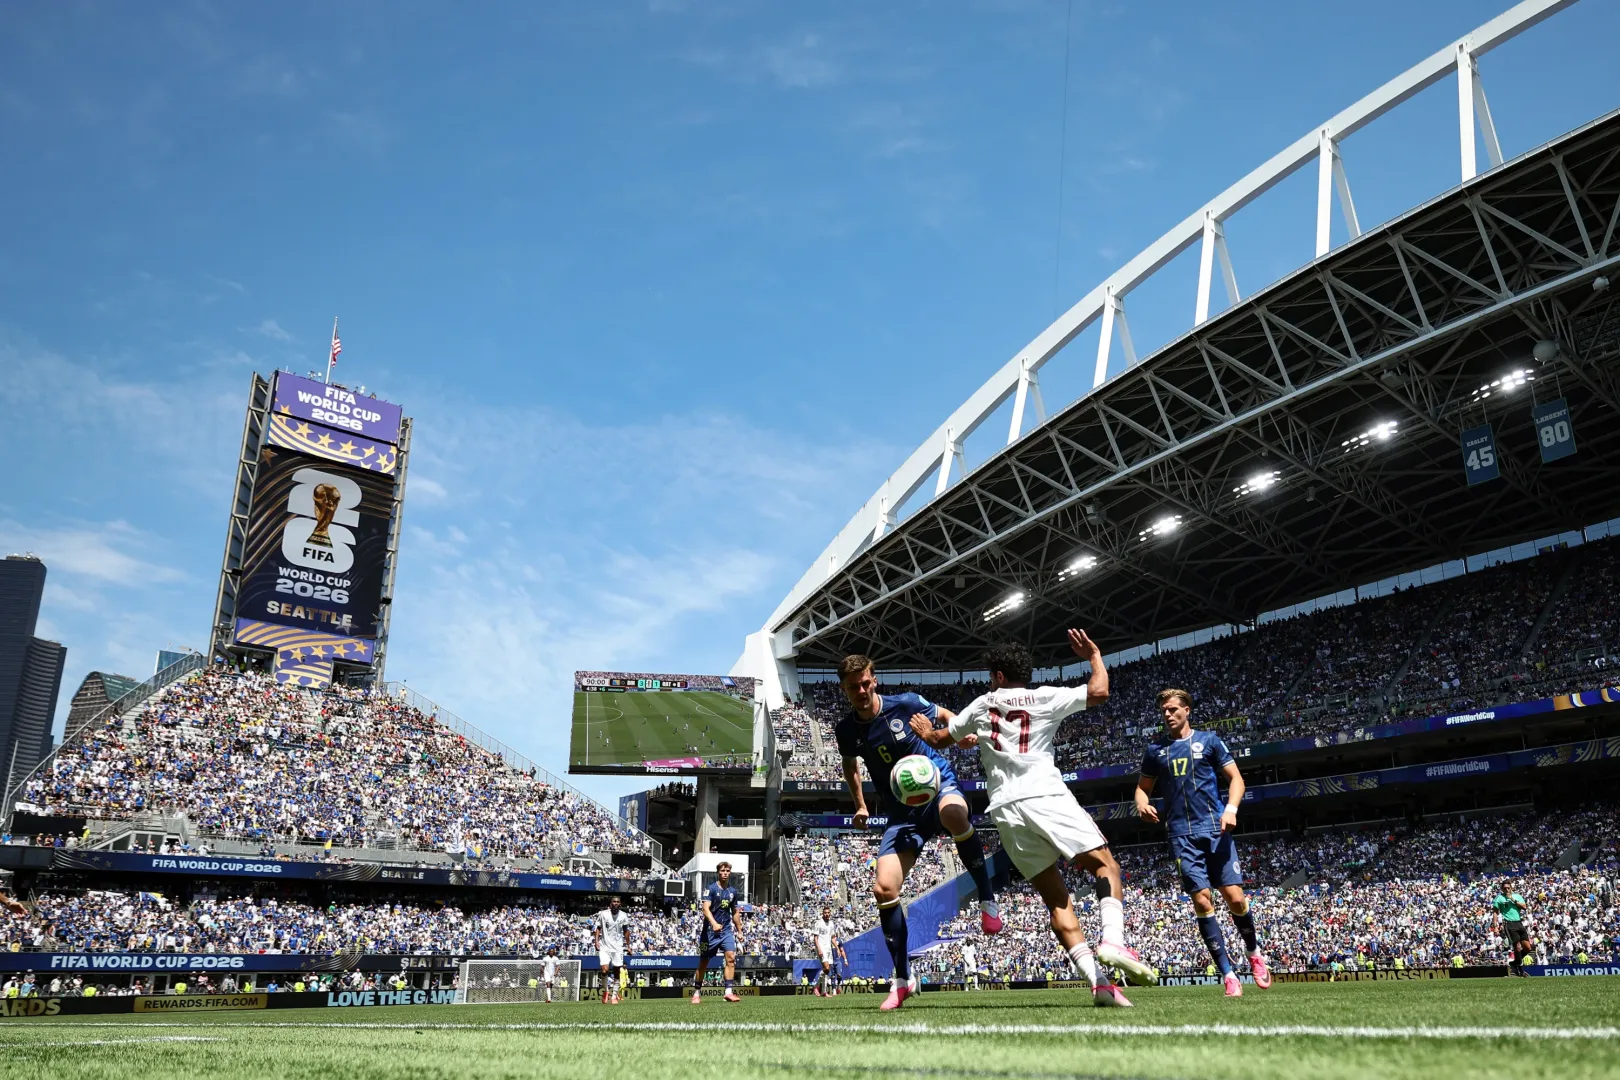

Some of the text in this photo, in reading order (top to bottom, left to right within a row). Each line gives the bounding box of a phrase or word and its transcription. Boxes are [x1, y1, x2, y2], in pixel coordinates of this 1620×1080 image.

[325, 387, 356, 405] FIFA
[297, 390, 381, 423] WORLD CUP
[311, 408, 363, 431] 2026
[1536, 409, 1567, 424] LARGENT
[1540, 420, 1570, 448] 80
[1466, 445, 1495, 471] 45
[302, 547, 335, 563] FIFA
[278, 566, 352, 589] WORLD CUP
[275, 578, 350, 604] 2026
[266, 600, 353, 627] SEATTLE
[1445, 711, 1496, 726] #FIFAWorldCup
[988, 707, 1031, 754] 17
[877, 744, 893, 764] 6
[646, 766, 679, 774] Hisense
[1171, 757, 1189, 777] 17
[1426, 760, 1490, 777] #FIFAWorldCup
[1061, 772, 1078, 782] 26
[797, 782, 842, 791] SEATTLE
[152, 859, 283, 873] FIFA WORLD CUP 2026
[381, 870, 425, 880] SEATTLE
[51, 955, 244, 968] FIFA WORLD CUP 2026
[400, 957, 459, 969] SEATTLE
[630, 958, 672, 967] #FIFAWorldCup
[1340, 971, 1373, 981] OUR
[1376, 969, 1451, 981] PASSION
[1544, 968, 1571, 976] FIFA
[1160, 978, 1192, 987] LOVE
[1194, 976, 1219, 985] THE
[327, 990, 464, 1006] LOVE THE GAME
[580, 988, 642, 1001] PASON
[144, 997, 259, 1009] REWARDS.FIFA.COM
